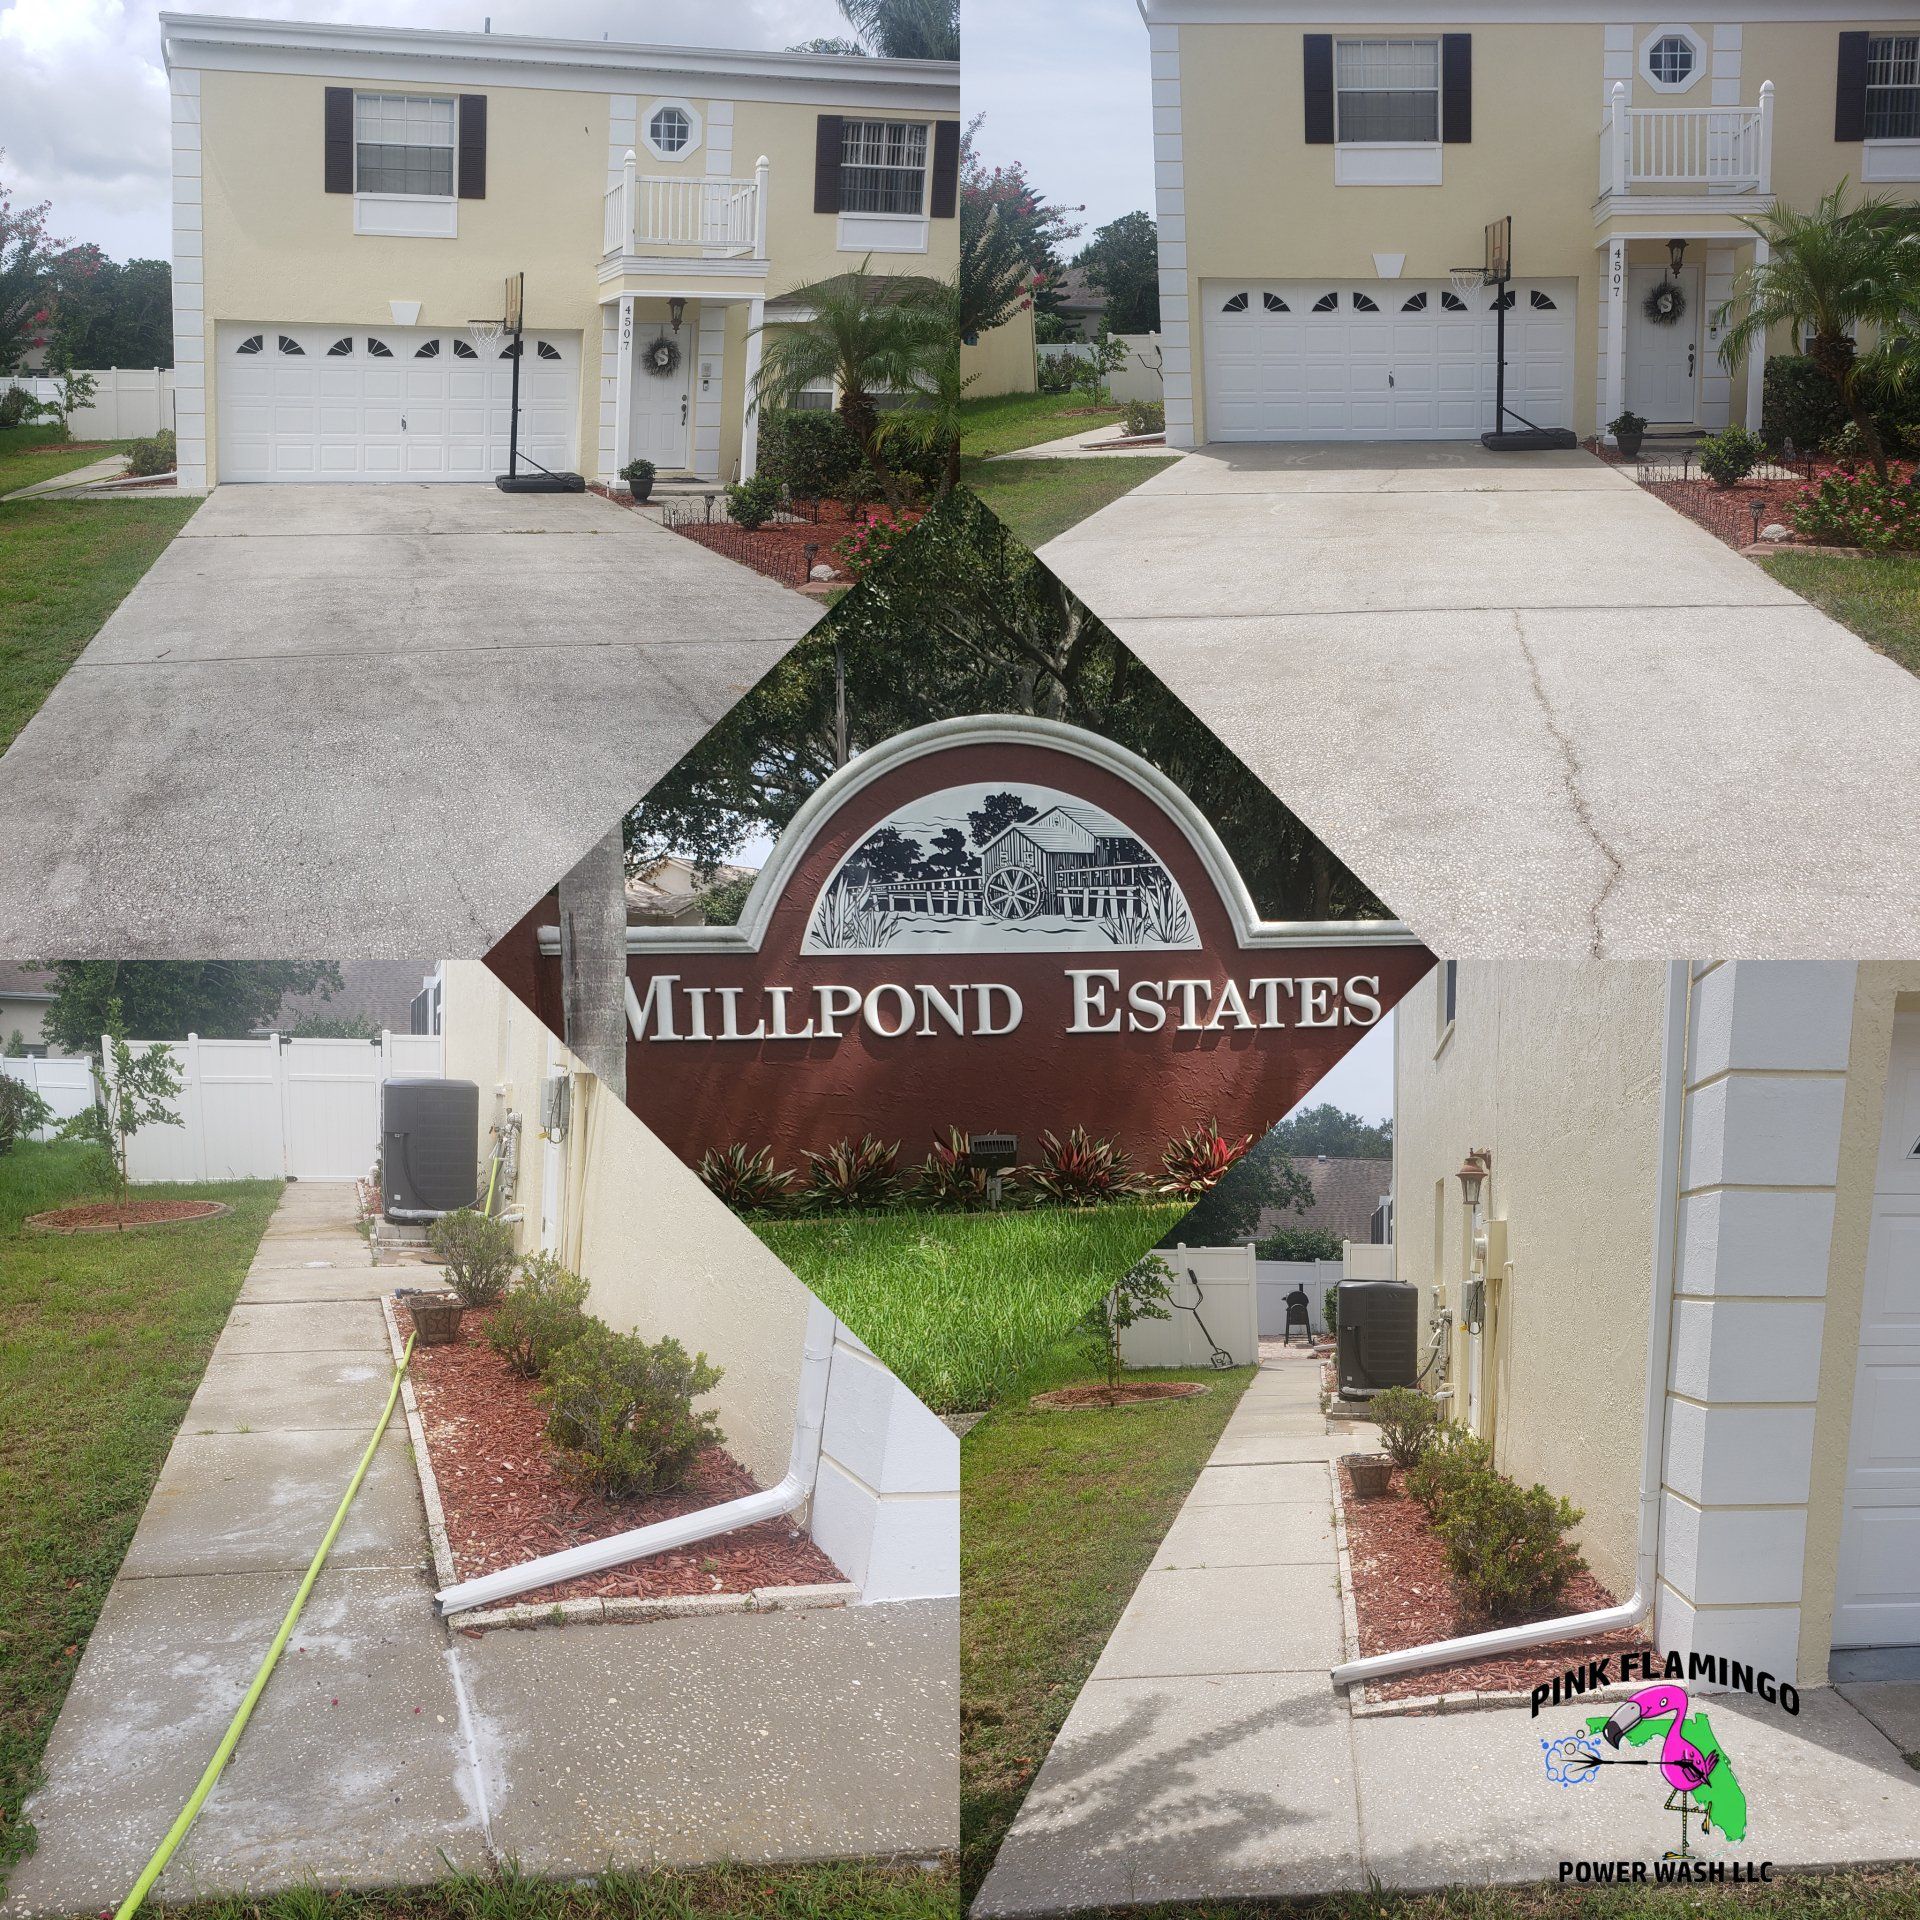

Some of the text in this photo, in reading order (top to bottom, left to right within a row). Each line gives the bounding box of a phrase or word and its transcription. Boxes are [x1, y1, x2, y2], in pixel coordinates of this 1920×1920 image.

[1613, 248, 1622, 297] 4507
[1656, 293, 1673, 314] S
[623, 305, 632, 351] 4507
[654, 347, 669, 367] S
[624, 968, 1382, 1042] MILLPOND ESTATES
